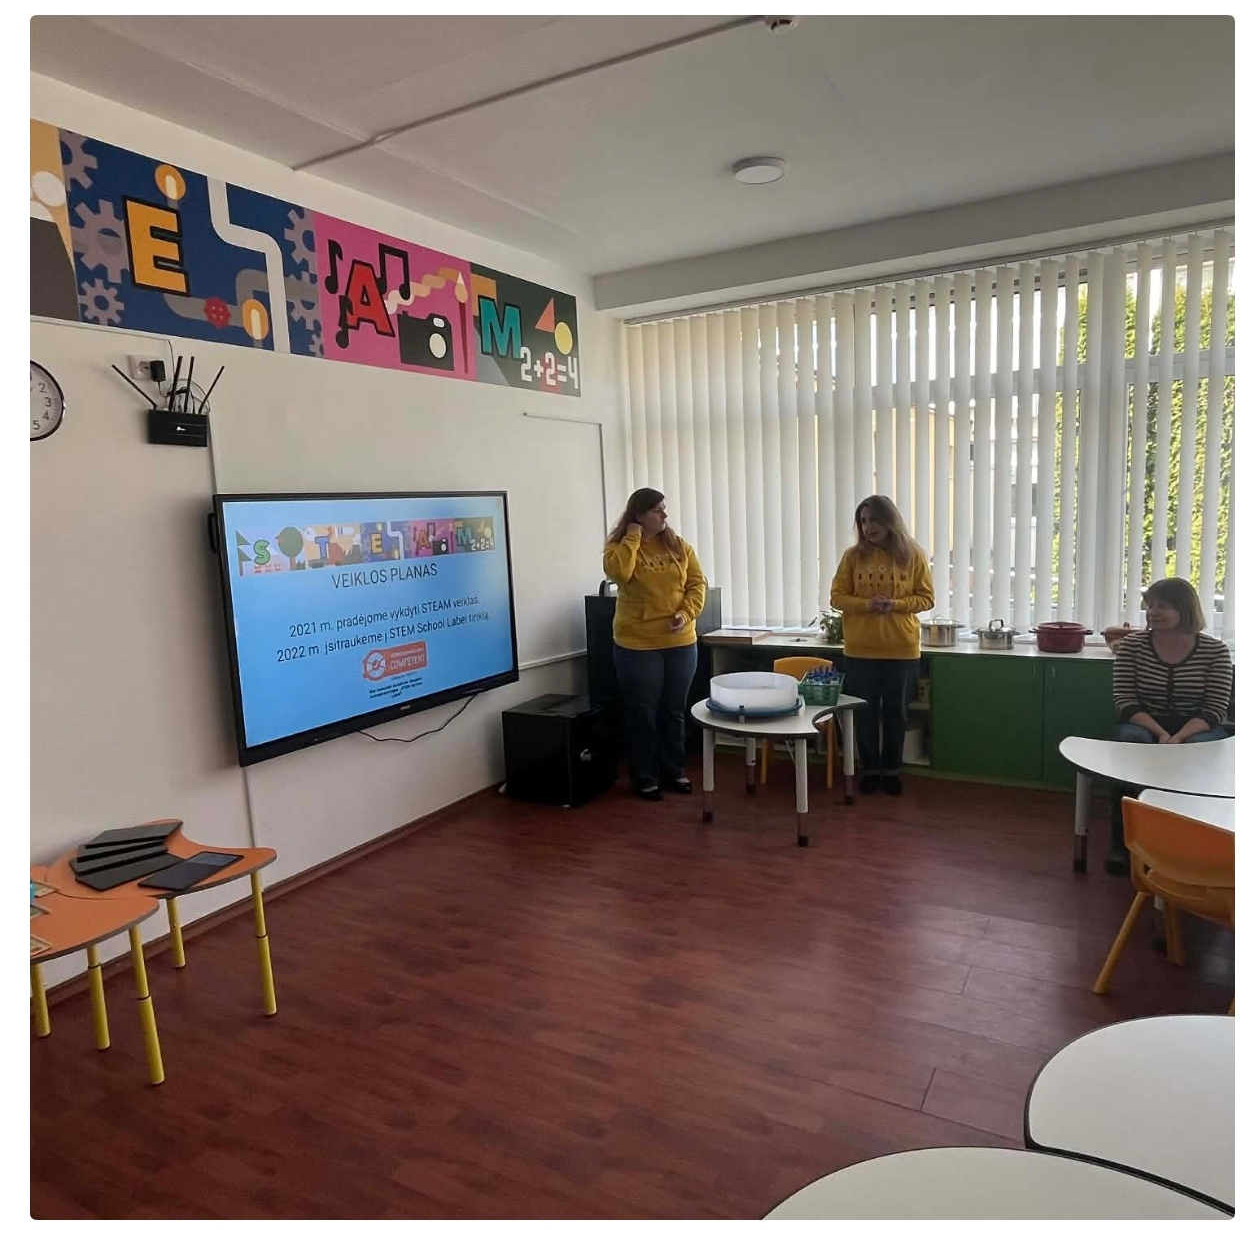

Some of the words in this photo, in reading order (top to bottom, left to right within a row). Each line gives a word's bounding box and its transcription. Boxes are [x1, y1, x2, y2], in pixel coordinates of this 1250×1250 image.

[122, 196, 190, 296] E
[343, 259, 396, 338] A
[477, 294, 523, 359] M
[520, 346, 579, 389] 2+2=4
[38, 383, 46, 393] 2
[44, 397, 52, 407] 3
[33, 420, 41, 431] 5
[42, 410, 50, 420] 4
[253, 539, 271, 565] S
[315, 536, 330, 561] T
[370, 533, 383, 554] E
[332, 567, 388, 589] VEIKLOS
[390, 563, 438, 582] PLANAS
[289, 622, 317, 638] 2021
[336, 611, 388, 631] pradėjome
[389, 605, 420, 623] vykdyti
[421, 599, 451, 615] STEAM
[276, 645, 306, 662] 2022
[389, 624, 415, 640] STEM
[417, 619, 445, 634] School
[447, 614, 467, 629] Label
